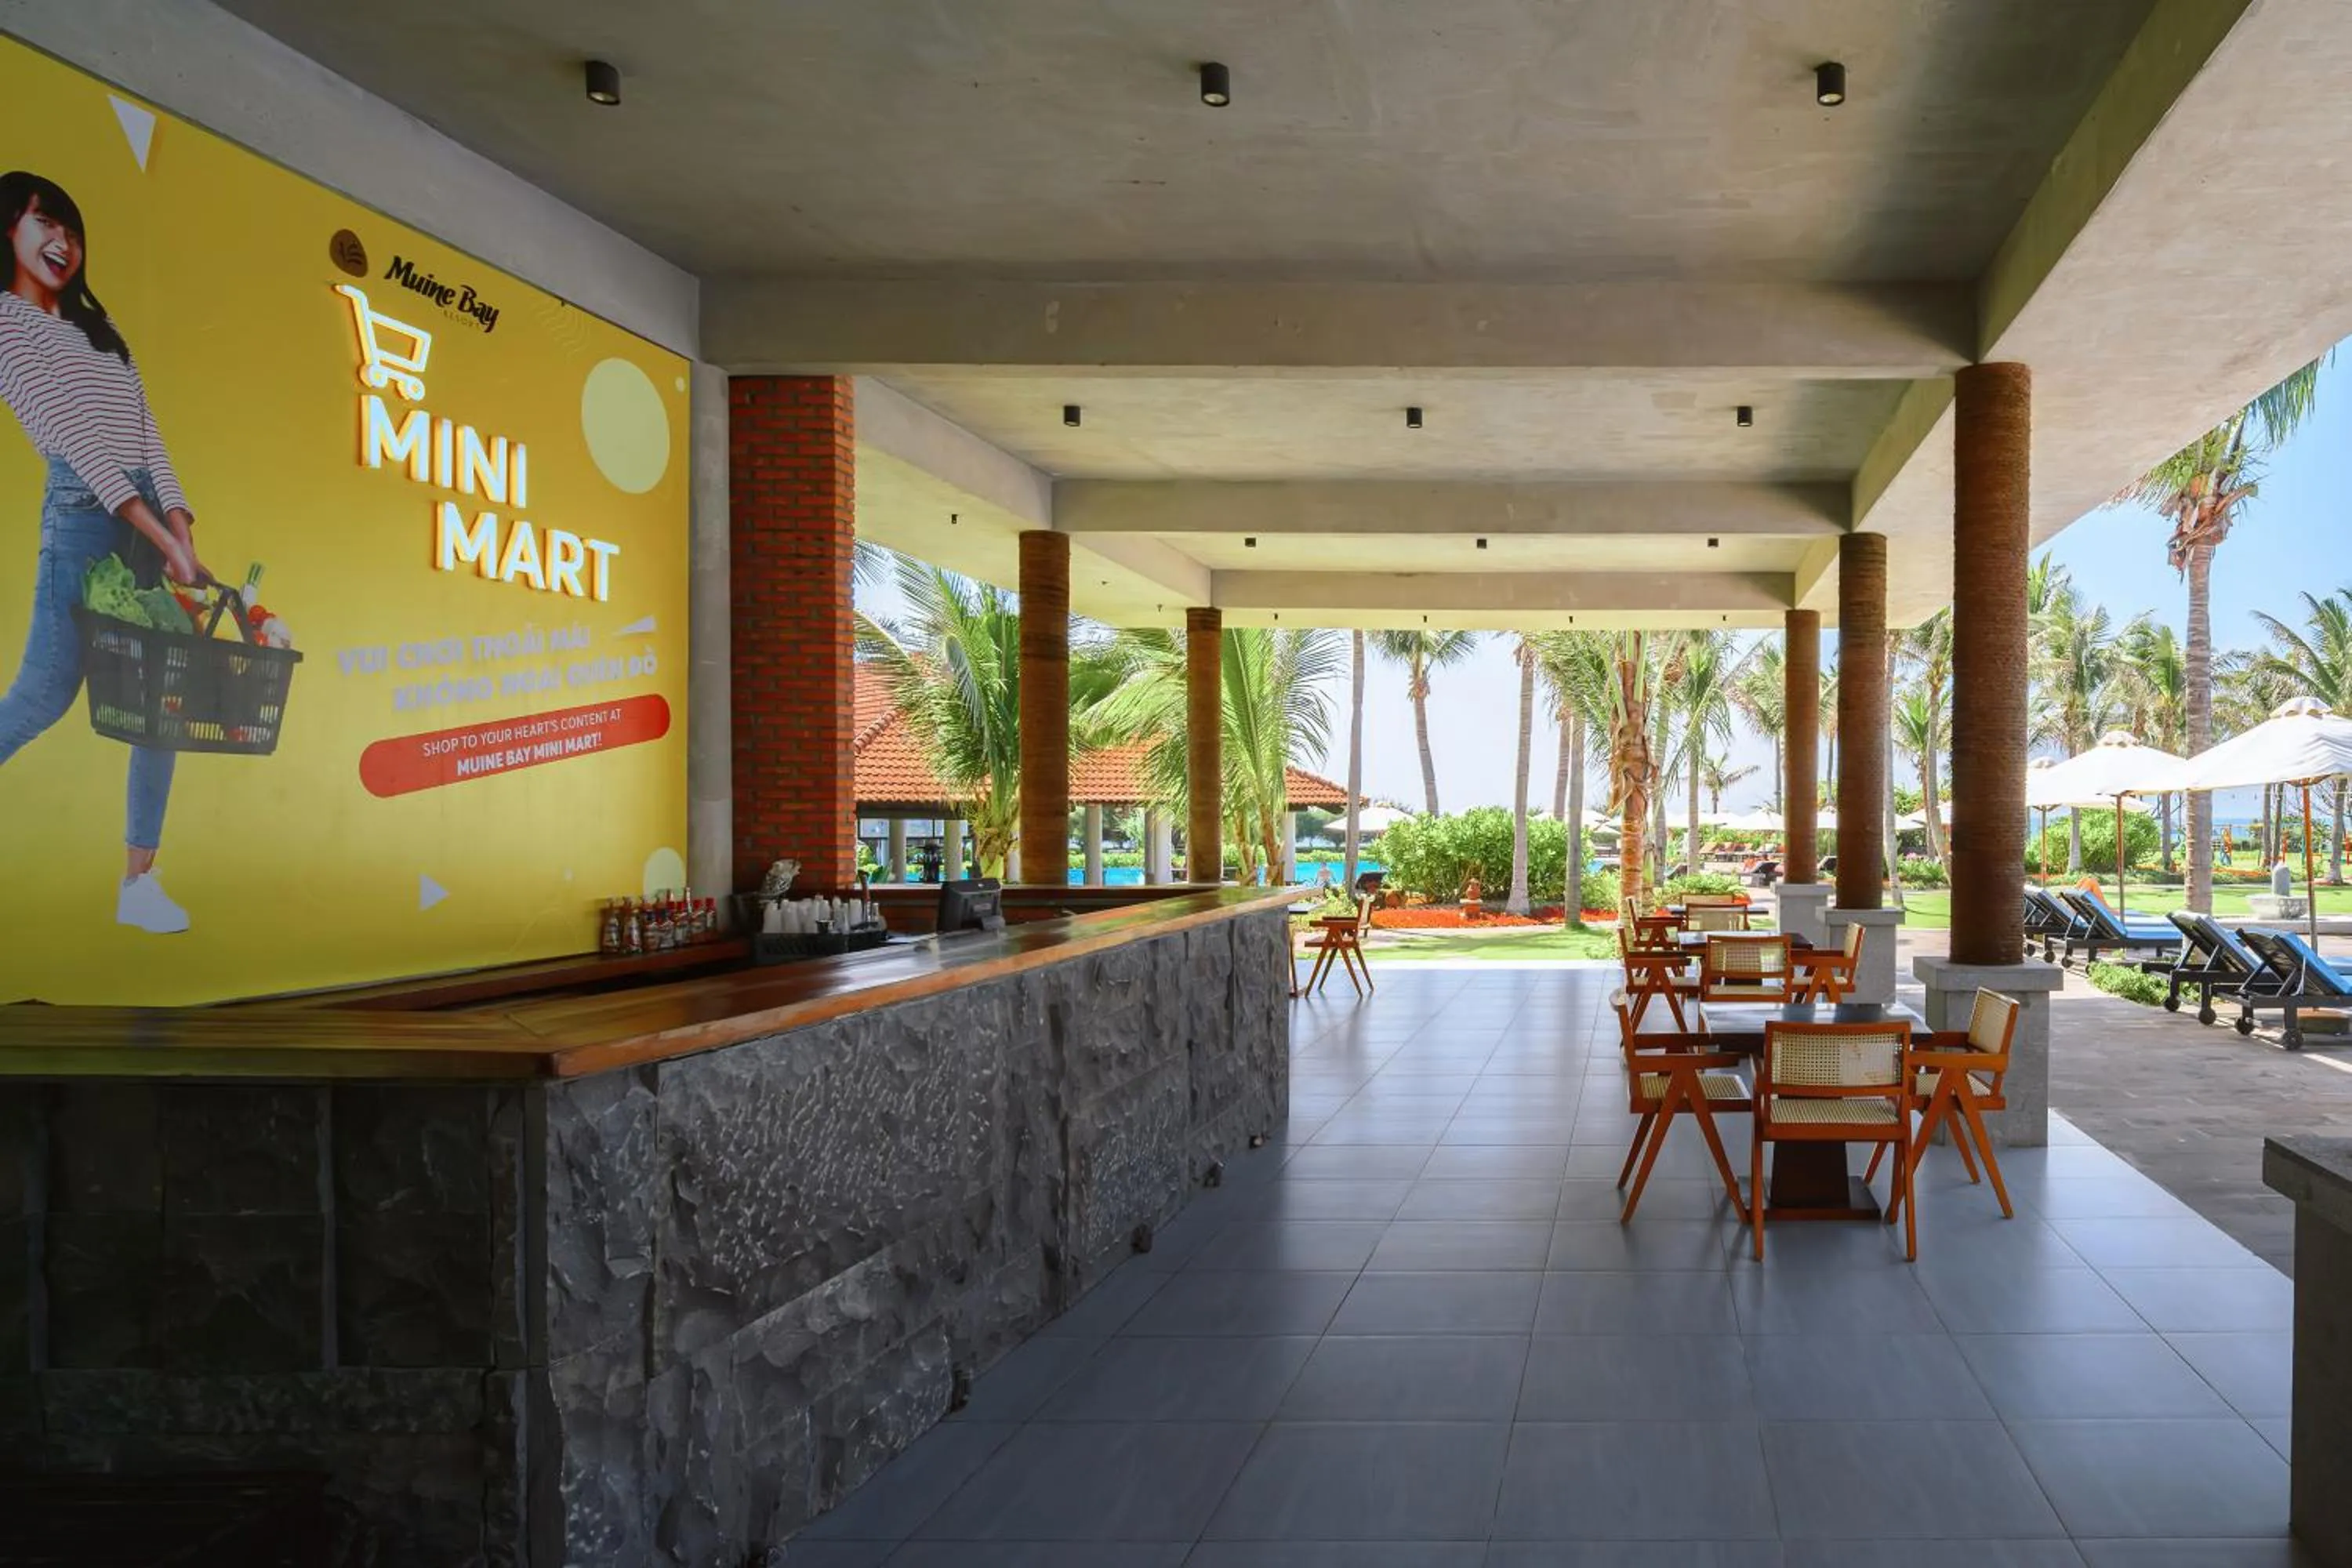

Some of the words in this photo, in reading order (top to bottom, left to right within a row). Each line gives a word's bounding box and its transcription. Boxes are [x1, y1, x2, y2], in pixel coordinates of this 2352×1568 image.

[383, 255, 456, 307] Muine
[457, 284, 500, 333] Bay
[361, 394, 528, 509] MINI
[434, 501, 621, 602] MART
[423, 739, 459, 757] SHOP
[463, 735, 477, 750] TO
[481, 728, 512, 746] YOUR
[514, 720, 560, 740] HEART'S
[561, 711, 608, 731] CONTENT
[609, 708, 622, 721] AT
[456, 753, 504, 776] MUINE
[506, 746, 531, 766] BAY
[534, 741, 562, 760] MINI
[564, 731, 602, 753] MART!
